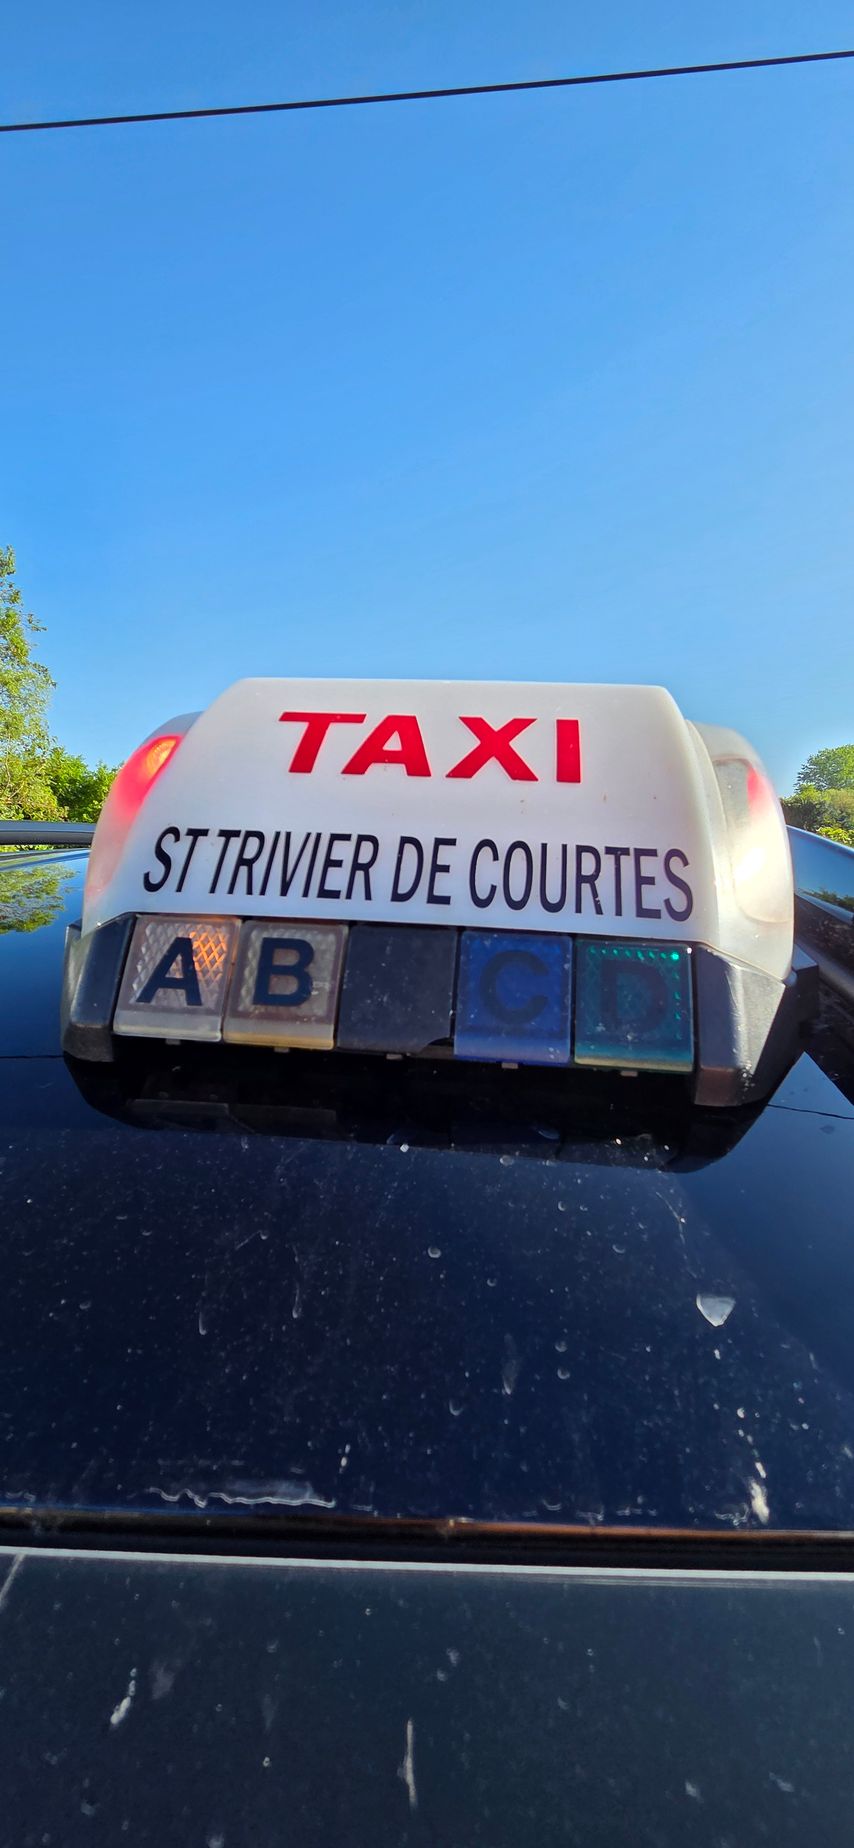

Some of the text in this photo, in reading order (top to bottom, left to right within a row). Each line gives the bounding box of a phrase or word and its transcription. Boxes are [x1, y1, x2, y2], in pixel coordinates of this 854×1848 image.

[279, 711, 582, 784] TAXI
[143, 826, 694, 922] ST TRIVIER DE COURTES
[136, 937, 203, 1006] A
[253, 937, 315, 1007] B
[478, 950, 550, 1025] C
[599, 959, 668, 1030] D
